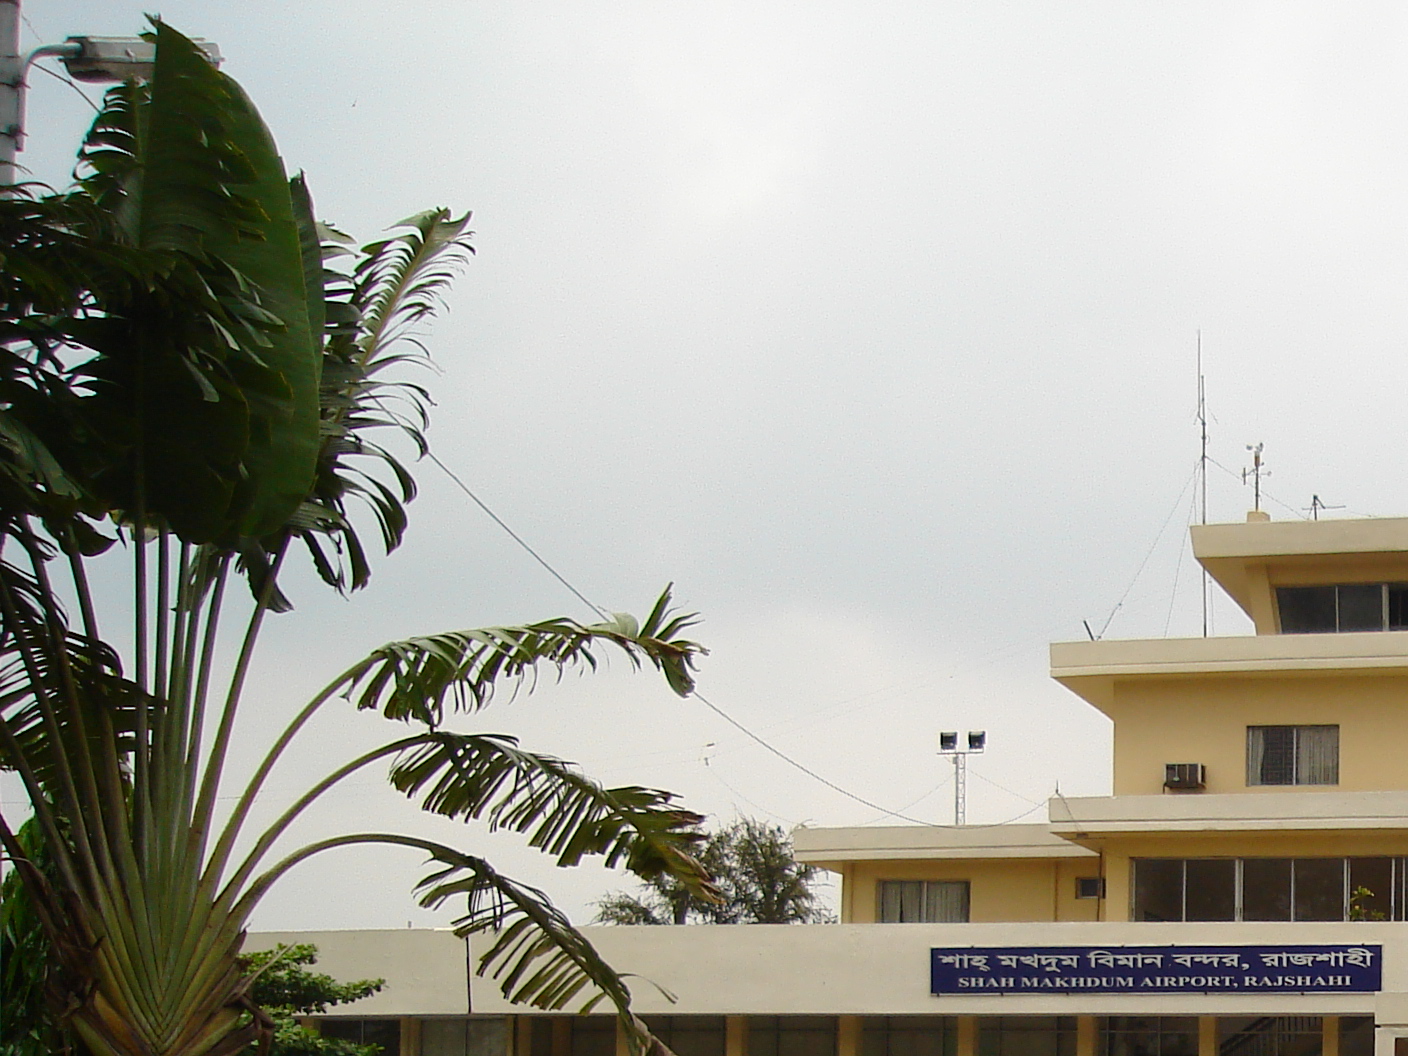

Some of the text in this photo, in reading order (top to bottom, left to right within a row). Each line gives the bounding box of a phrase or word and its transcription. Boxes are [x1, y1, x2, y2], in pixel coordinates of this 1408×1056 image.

[1087, 951, 1164, 969] বিমান
[1171, 953, 1250, 971] বন্দর,
[1259, 948, 1374, 968] রাজশাহী
[958, 975, 1352, 989] SHAH MAKHDUM AIRPORT, RAJSHAHI
